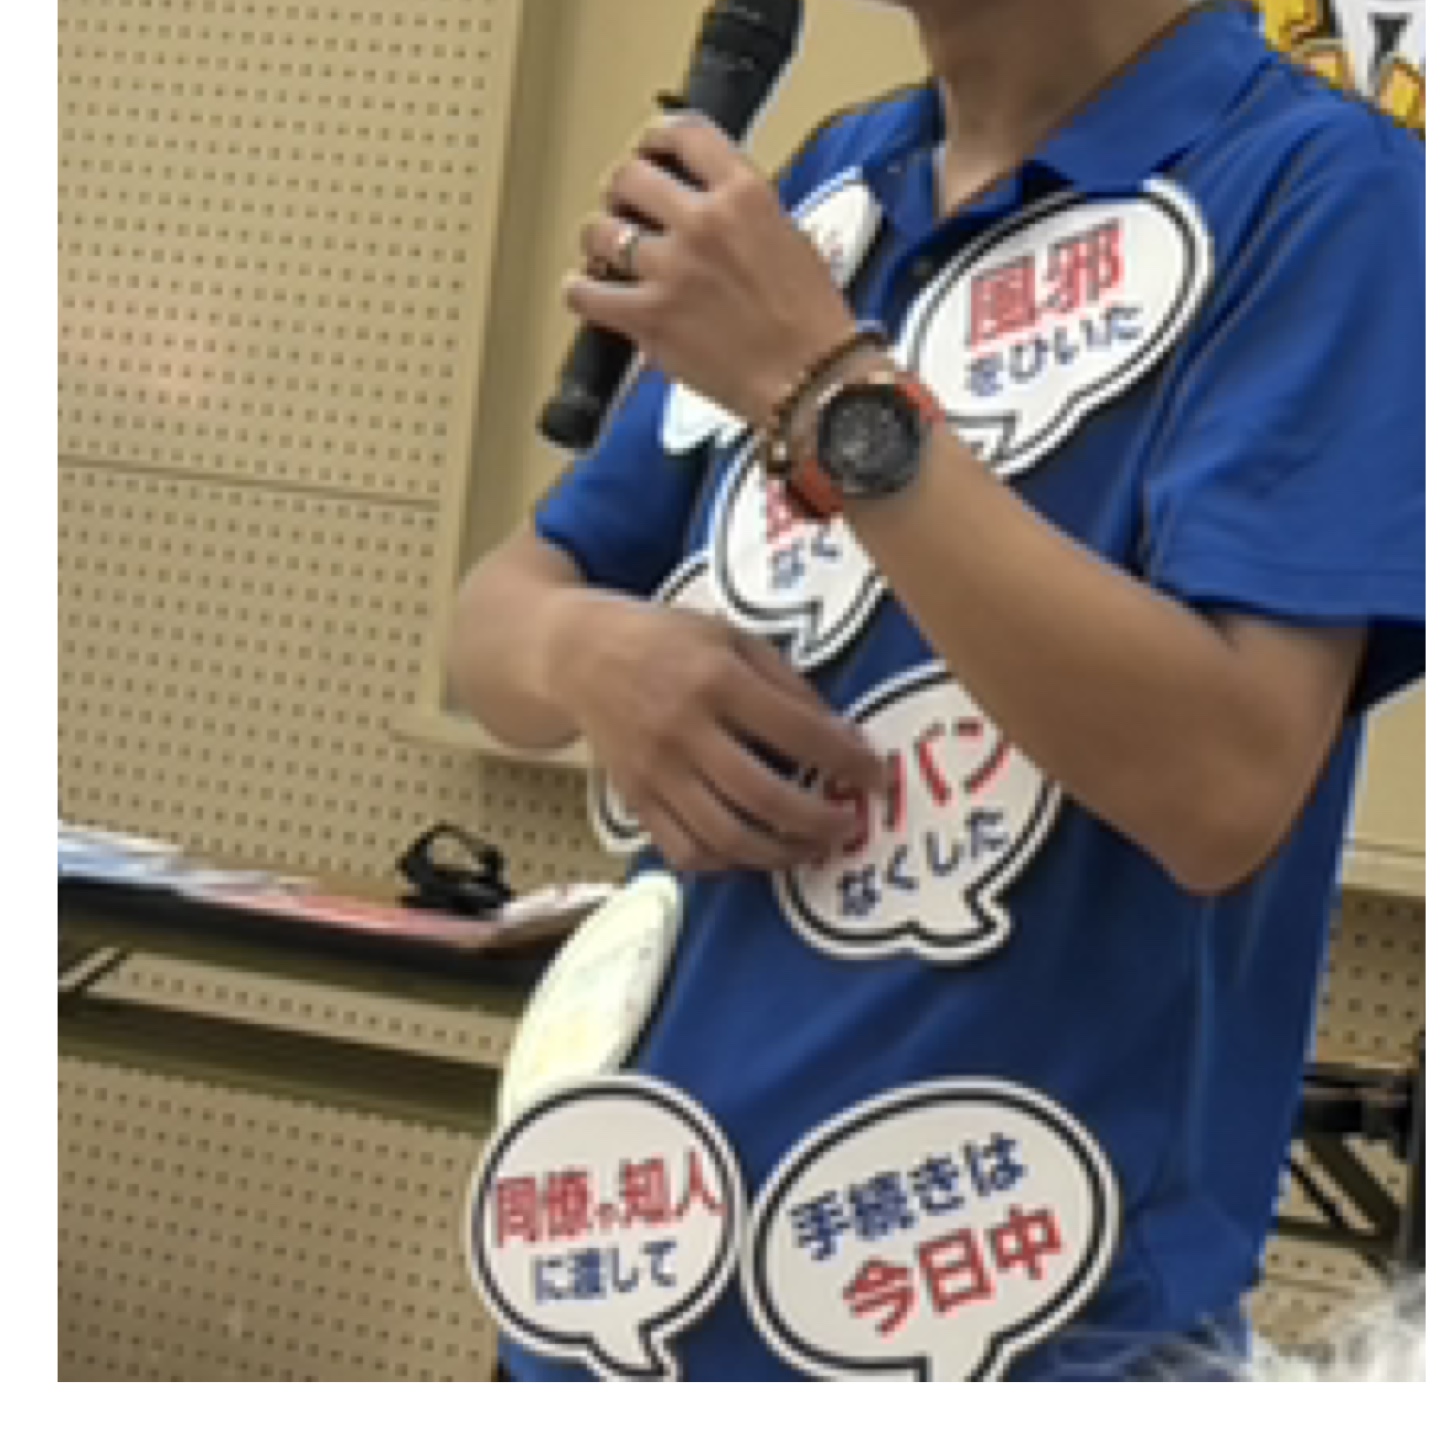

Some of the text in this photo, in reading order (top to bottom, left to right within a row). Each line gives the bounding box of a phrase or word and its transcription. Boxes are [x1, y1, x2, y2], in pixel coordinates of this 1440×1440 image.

[969, 219, 1127, 349] 風邪
[965, 304, 1143, 397] をひいた
[836, 807, 1010, 918] なくした
[790, 1132, 1024, 1262] 手続きは
[530, 1239, 679, 1304] に渡して
[841, 1204, 1062, 1336] 今日中
